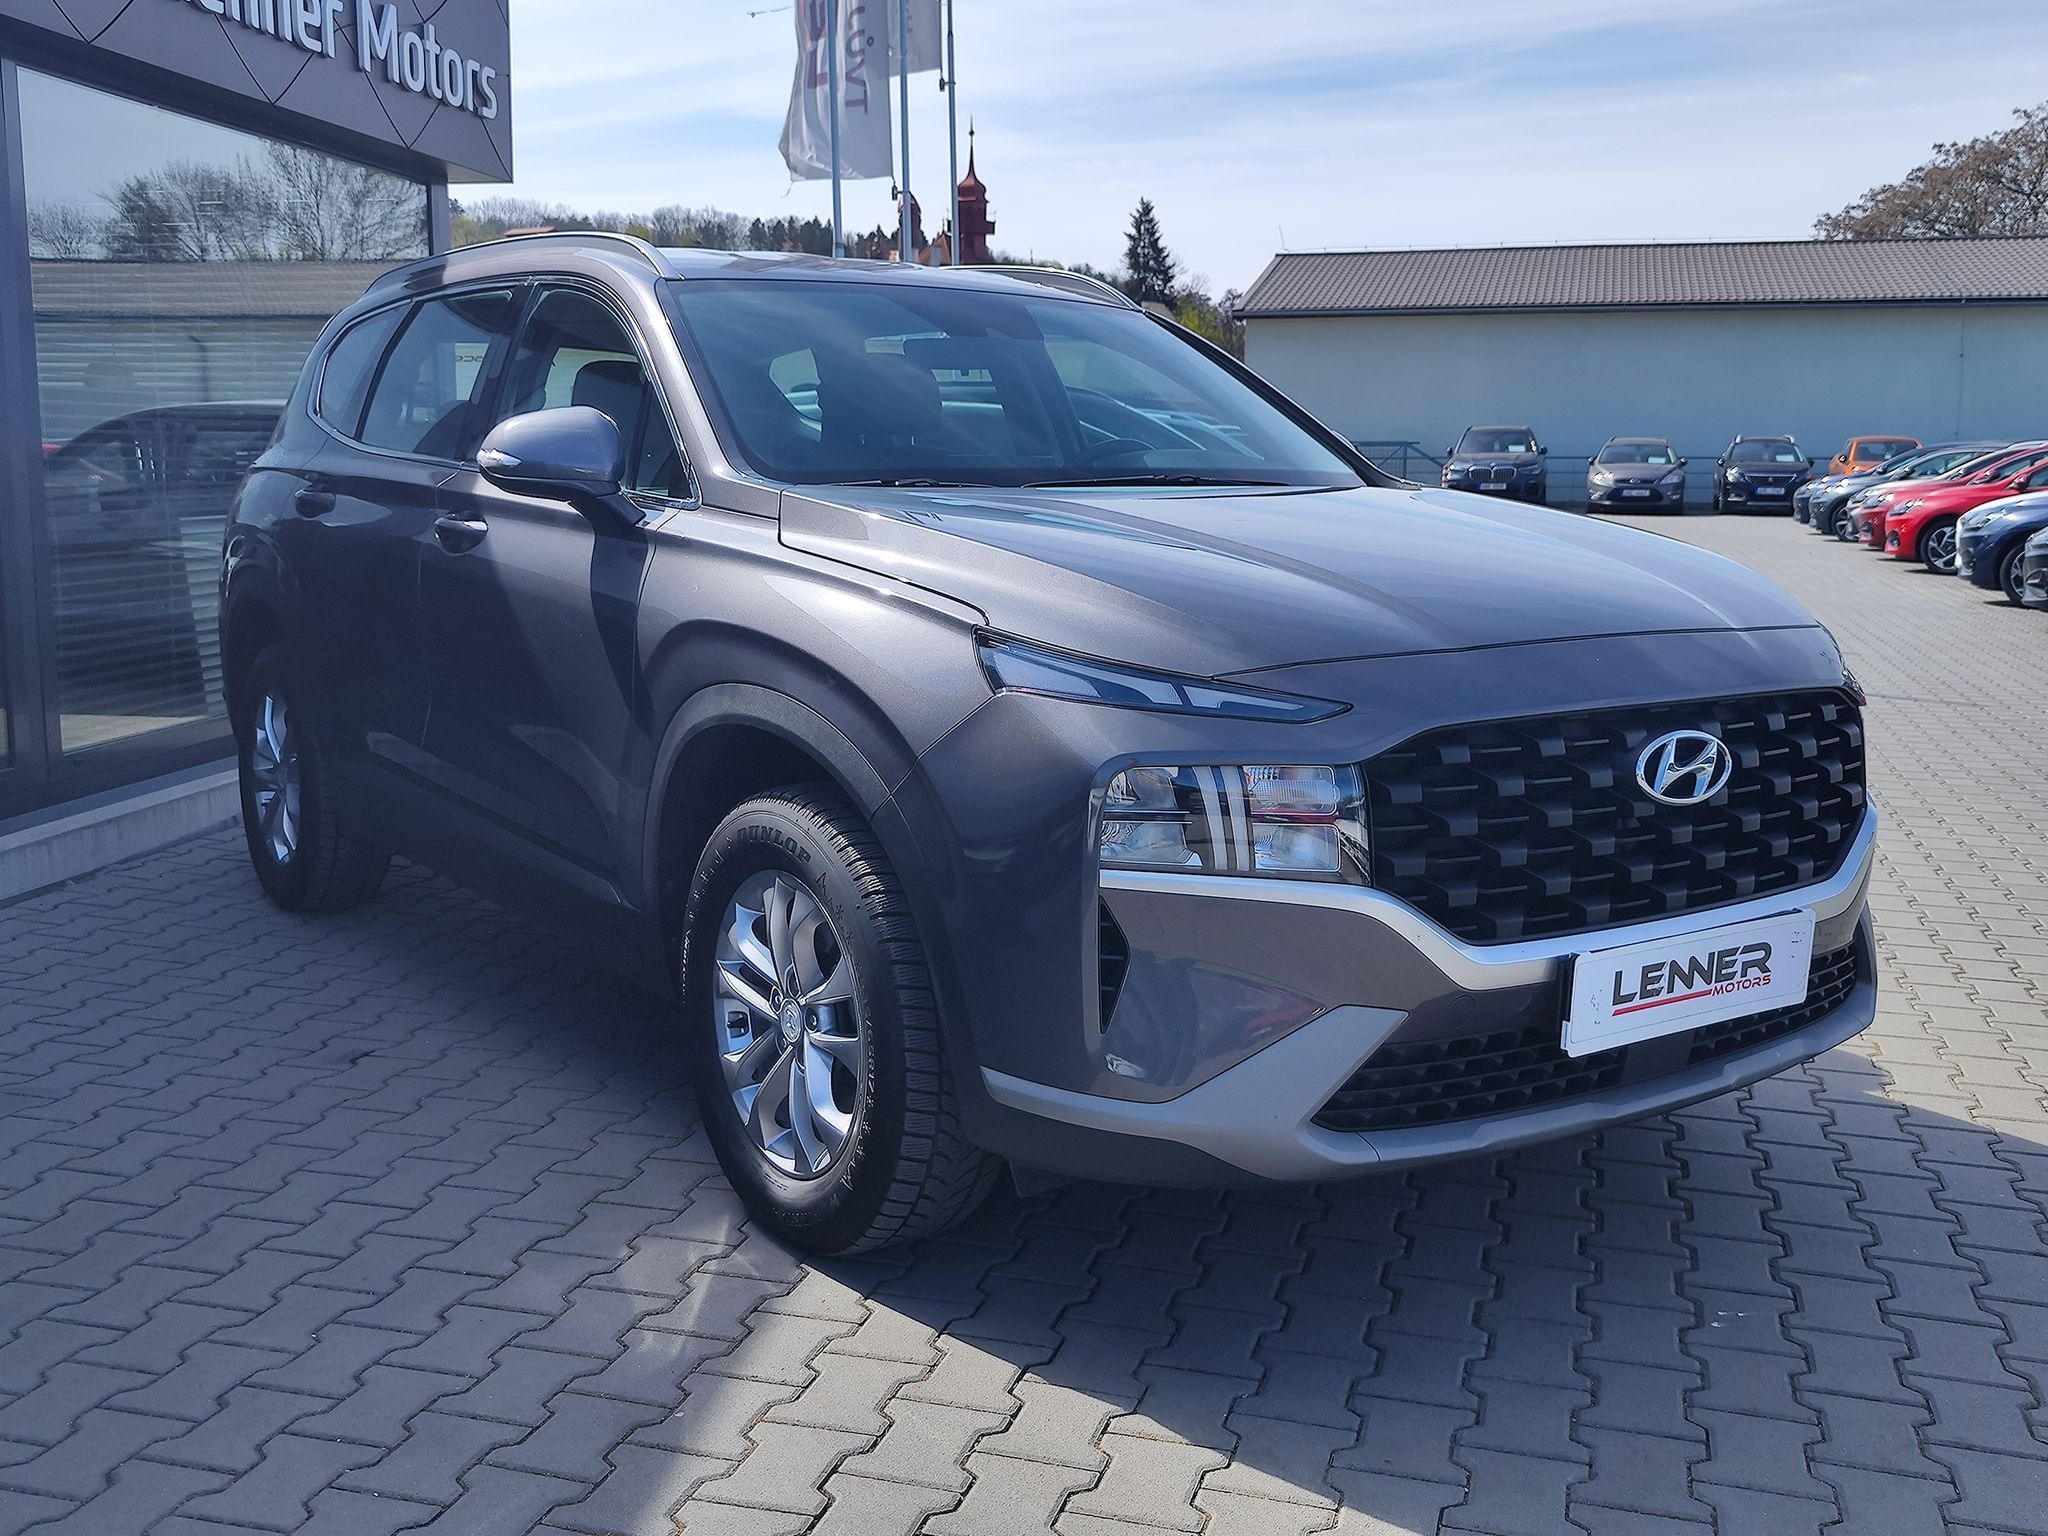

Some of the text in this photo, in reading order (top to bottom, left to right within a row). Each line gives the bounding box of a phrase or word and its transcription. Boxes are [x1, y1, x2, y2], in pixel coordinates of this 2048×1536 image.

[357, 0, 498, 119] Motors
[736, 825, 811, 864] DUNLOP
[1612, 942, 1772, 1006] LENNER
[1711, 975, 1771, 997] MOTORS
